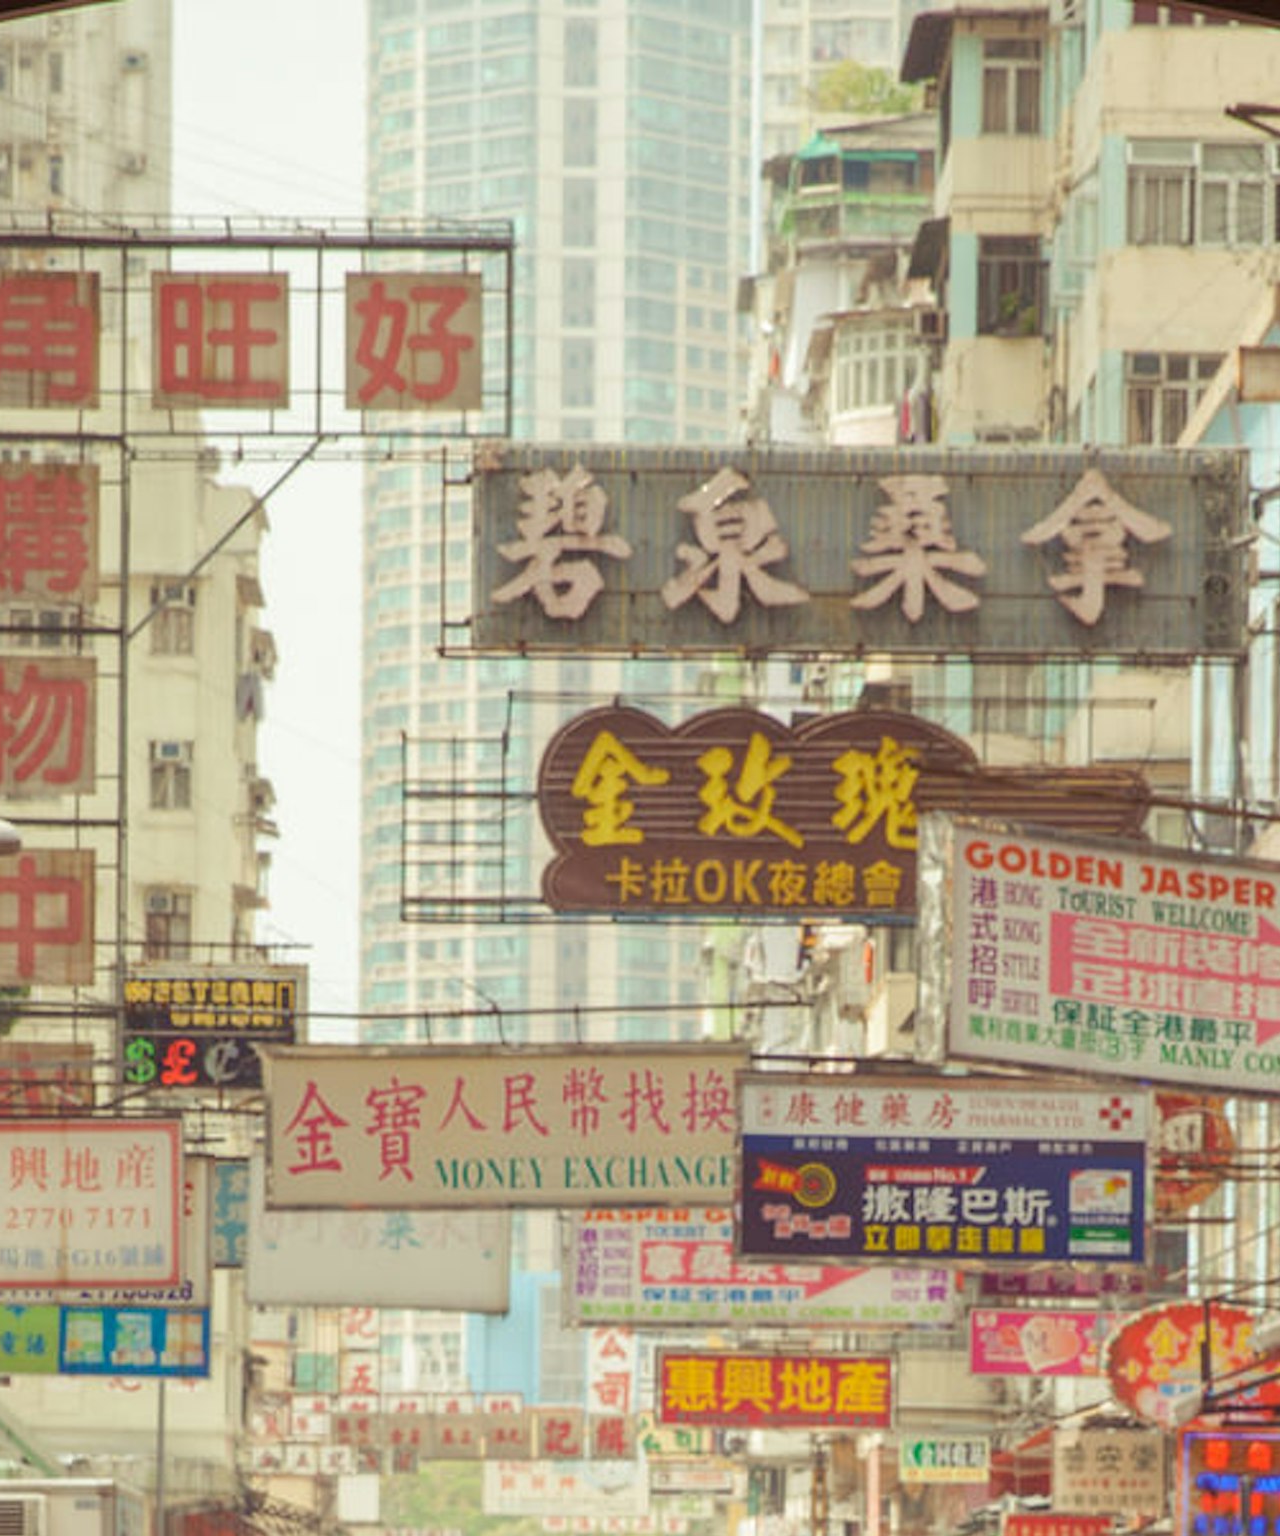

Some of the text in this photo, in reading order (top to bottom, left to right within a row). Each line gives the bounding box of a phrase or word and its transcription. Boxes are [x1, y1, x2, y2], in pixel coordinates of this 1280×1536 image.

[492, 464, 1173, 627] 碧泉桑拿
[571, 730, 919, 850] 金玫瑰
[605, 857, 903, 908] 卡拉OK夜總會
[964, 840, 1124, 889] GOLDEN
[1139, 864, 1276, 910] JASPER
[968, 876, 1000, 1010] 港式招呼
[1151, 899, 1250, 937] WELLCOME
[124, 980, 276, 1005] WESTERN
[1160, 1043, 1236, 1070] MANLY
[283, 1066, 736, 1183] 金寶 人民幣找換
[783, 1091, 962, 1131] 康健藥房
[434, 1156, 546, 1190] MONEY
[563, 1154, 734, 1189] EXCHANGE
[4, 1207, 153, 1230] 2770 7171
[664, 1358, 890, 1414] 惠興地產
